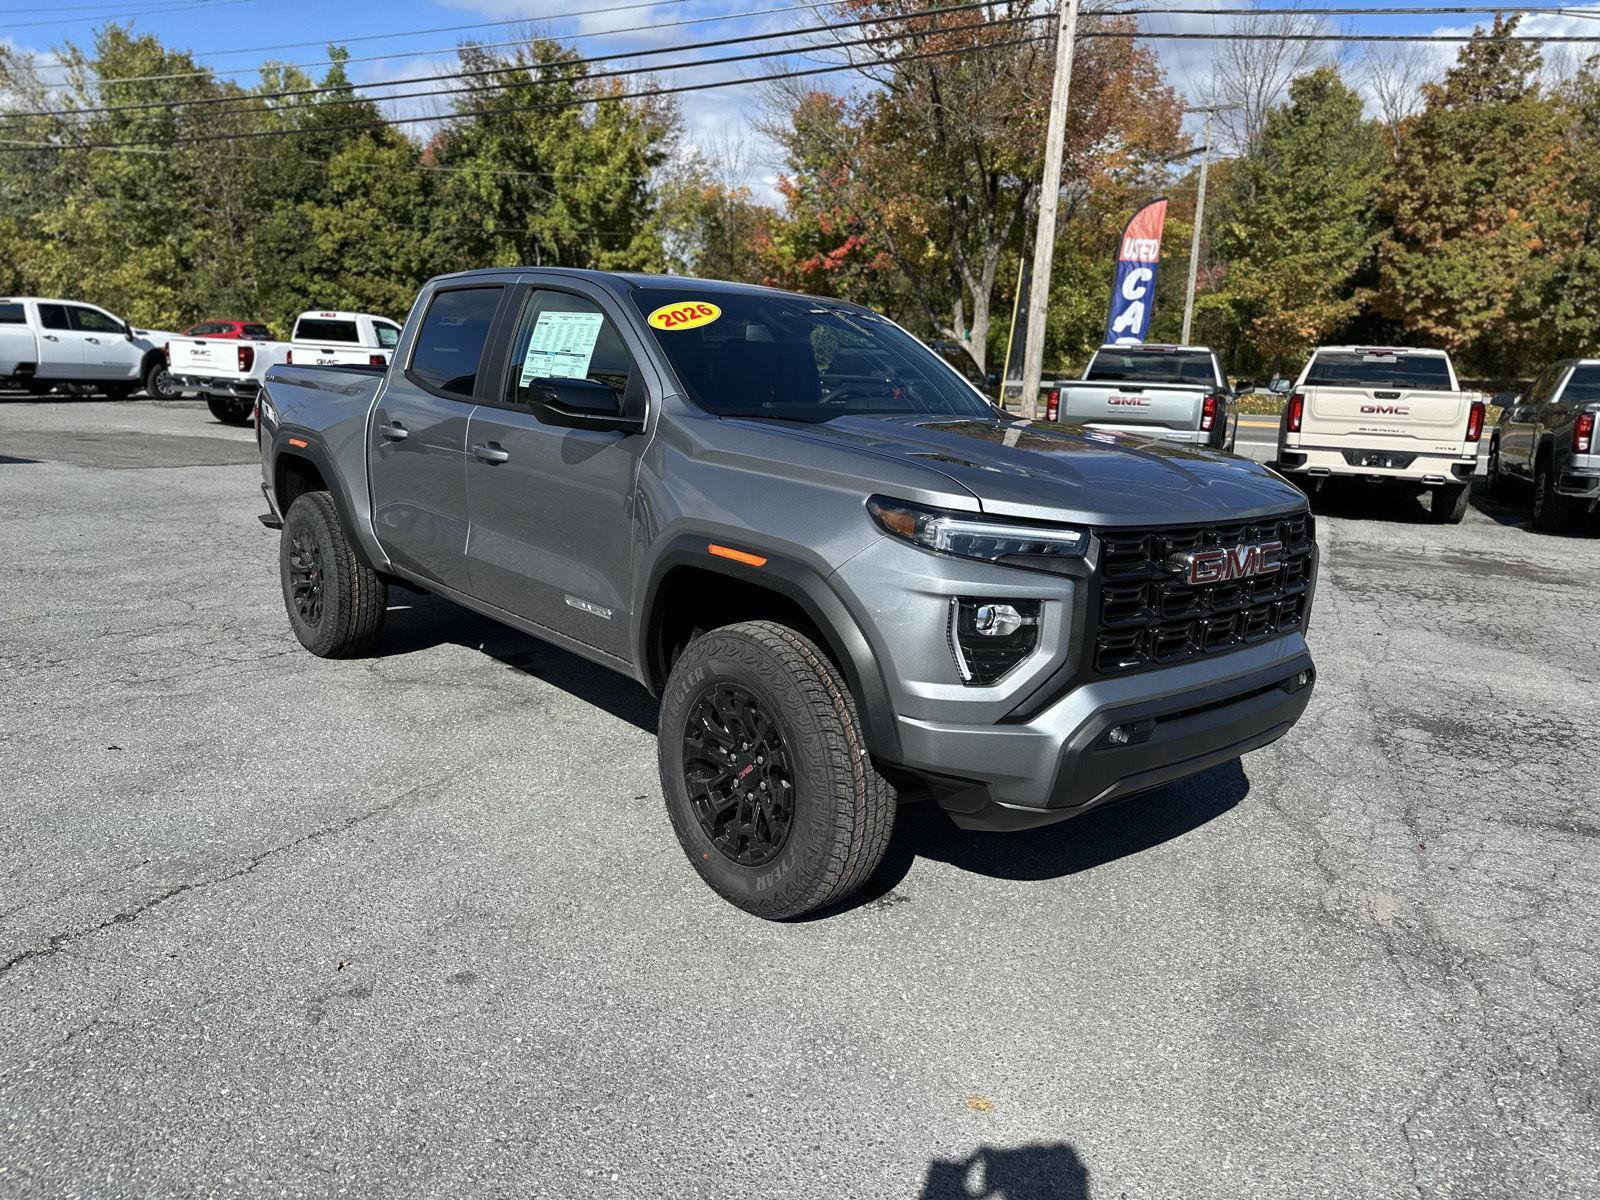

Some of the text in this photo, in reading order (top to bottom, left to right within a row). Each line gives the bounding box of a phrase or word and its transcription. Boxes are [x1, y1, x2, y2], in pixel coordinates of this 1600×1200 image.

[1122, 236, 1158, 261] USED
[657, 304, 713, 328] 2026
[1107, 396, 1151, 407] GMC
[1360, 404, 1411, 416] GMC
[1187, 540, 1283, 585] GMC
